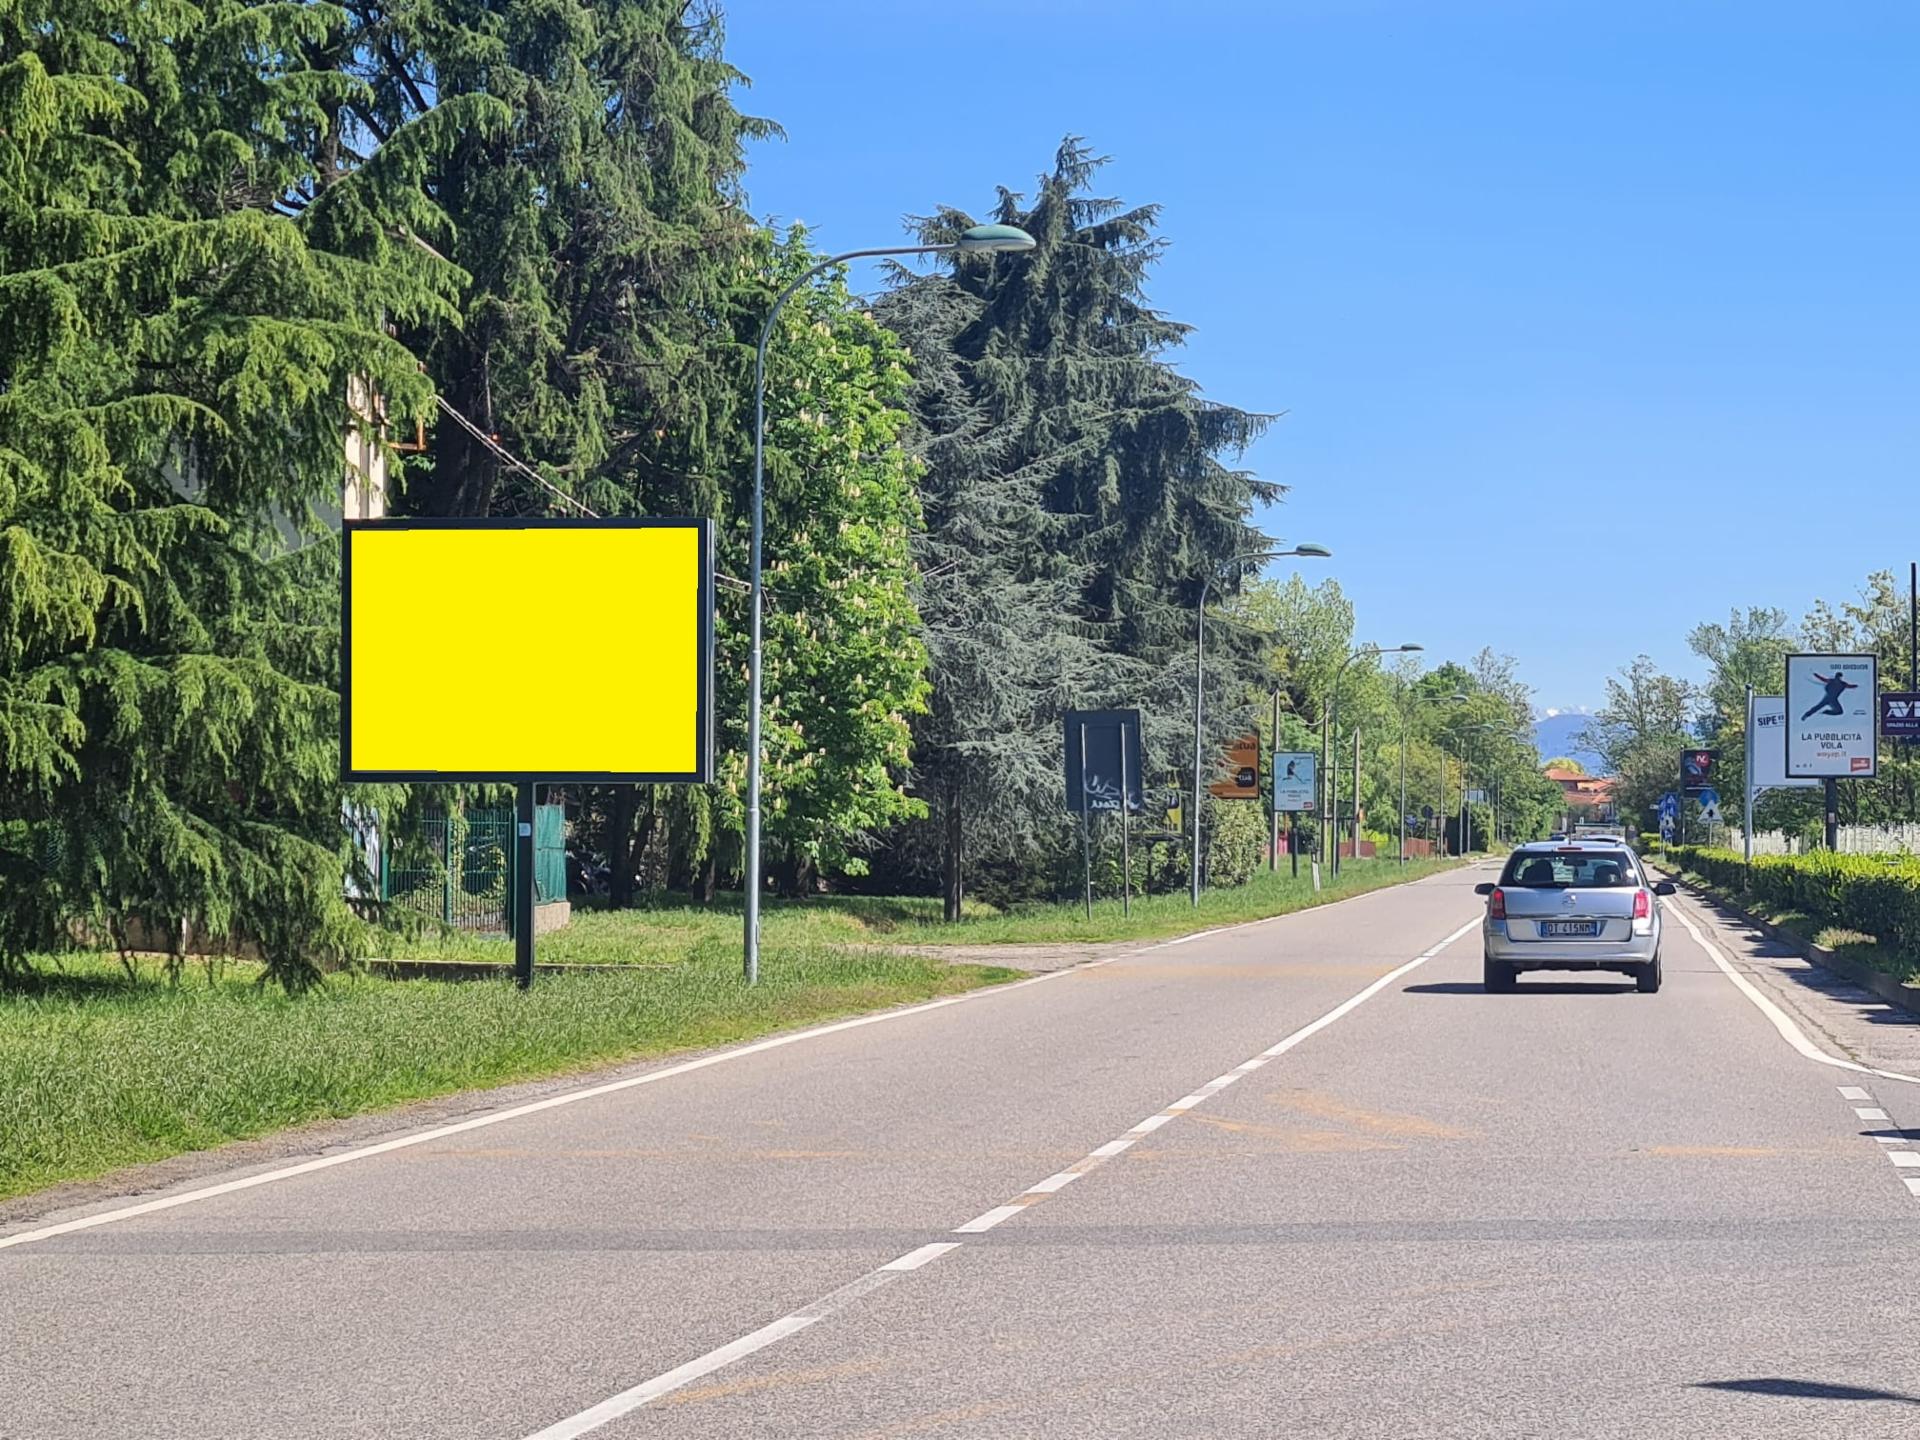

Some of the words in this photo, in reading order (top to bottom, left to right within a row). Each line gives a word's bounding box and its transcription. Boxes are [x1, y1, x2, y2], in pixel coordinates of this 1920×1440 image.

[1757, 715, 1778, 726] SIPE
[1801, 733, 1813, 741] LA
[1820, 741, 1843, 750] VOLA
